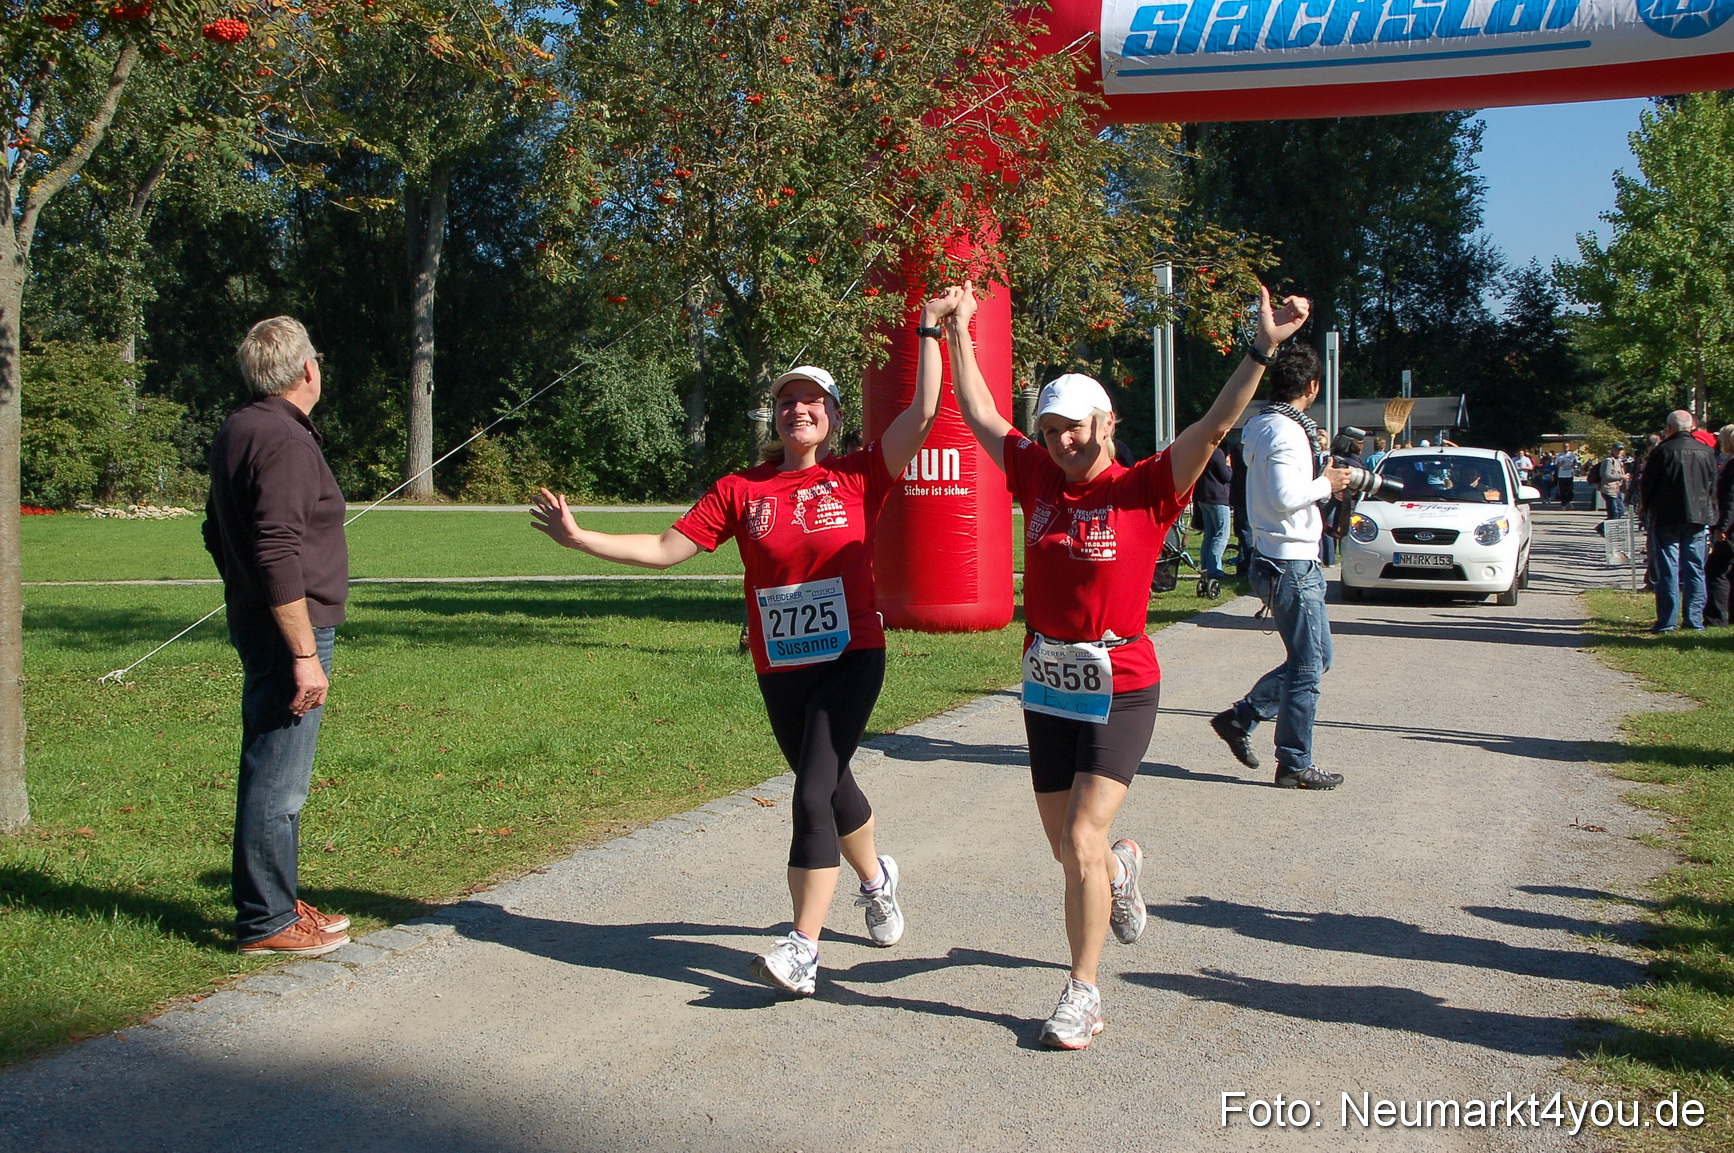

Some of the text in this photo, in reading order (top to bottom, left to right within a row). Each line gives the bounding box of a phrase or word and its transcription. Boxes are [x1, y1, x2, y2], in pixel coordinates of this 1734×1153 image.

[904, 484, 969, 496] Sicher ist sicher
[1401, 552, 1453, 567] NM RK 153
[767, 591, 803, 603] PFLEIDERER
[768, 600, 838, 638] 2725
[776, 636, 838, 656] Susanne
[1029, 656, 1101, 691] 3558
